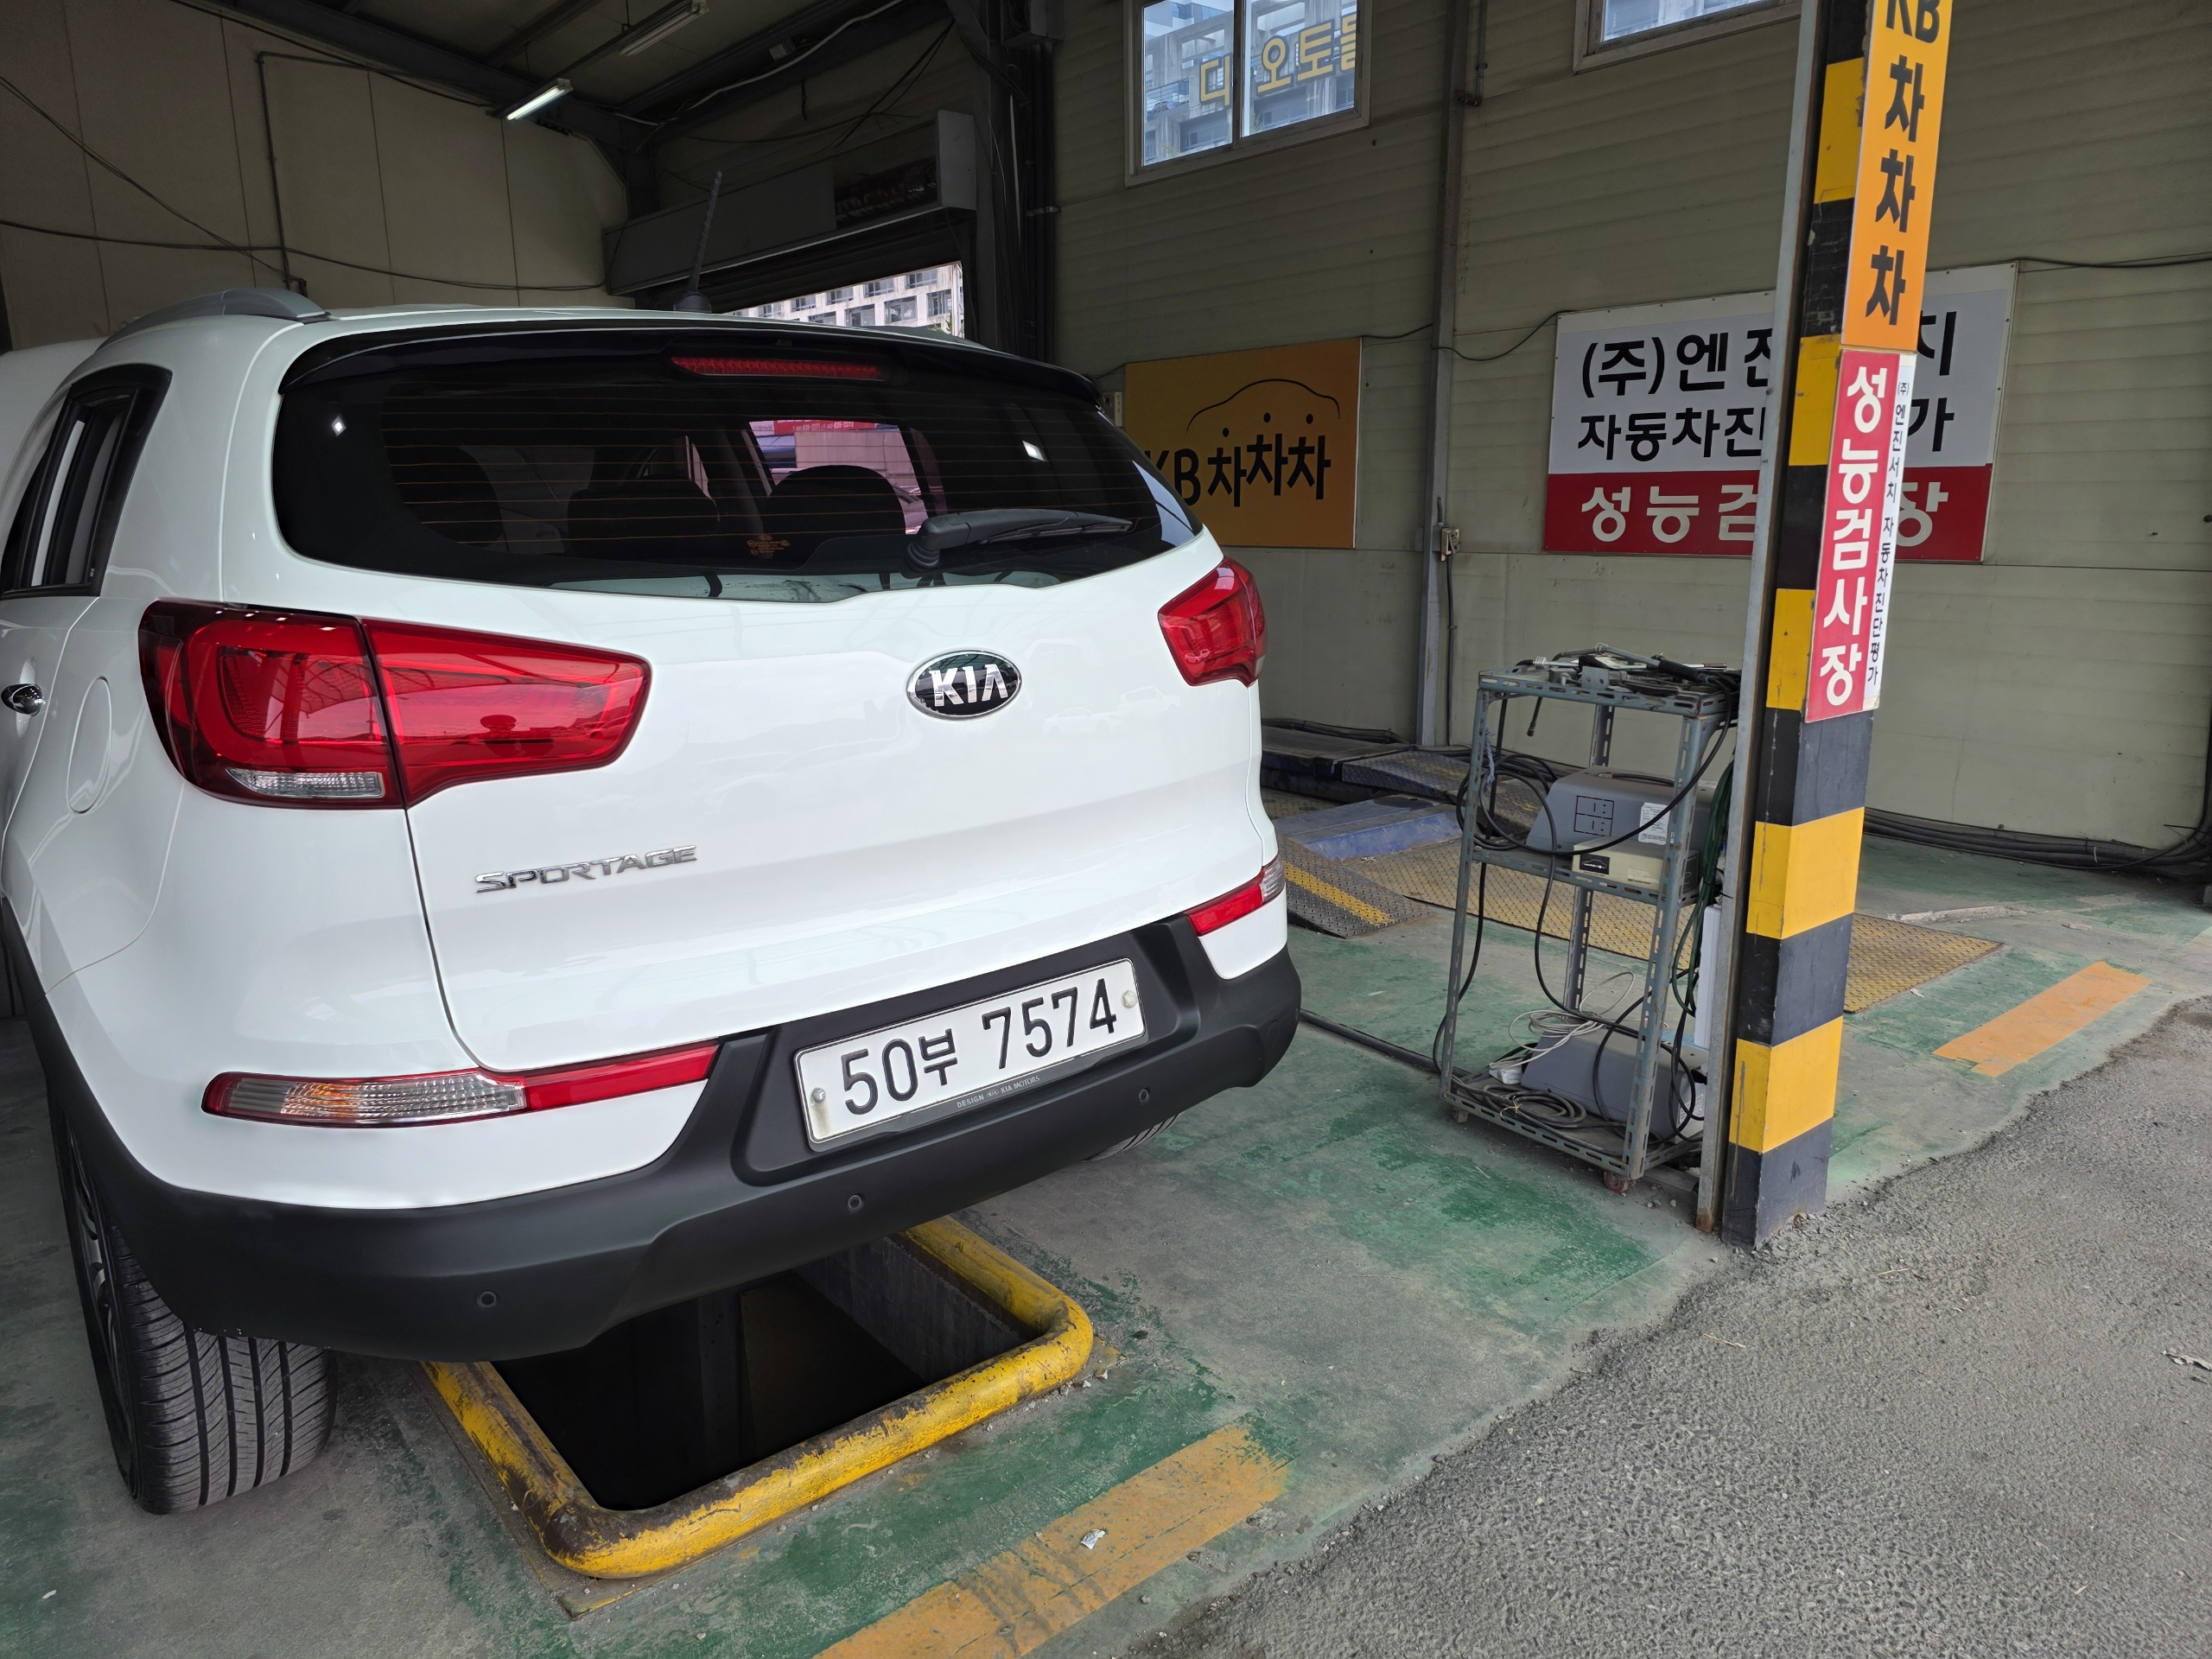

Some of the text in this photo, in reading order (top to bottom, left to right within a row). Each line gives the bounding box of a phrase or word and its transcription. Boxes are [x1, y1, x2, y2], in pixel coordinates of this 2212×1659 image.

[1581, 311, 1957, 398] (주)엔진치
[1577, 397, 1955, 462] 자동차진가
[1581, 481, 1949, 547] 성능검장
[1820, 365, 1888, 707] 성능검사장
[928, 663, 1009, 708] KIA
[475, 844, 697, 893] SPORTAGE
[841, 977, 1117, 1116] 50부 7574
[957, 1093, 985, 1109] DESIGN
[1000, 1084, 1013, 1094] KIA
[1013, 1075, 1040, 1090] MOTORS
